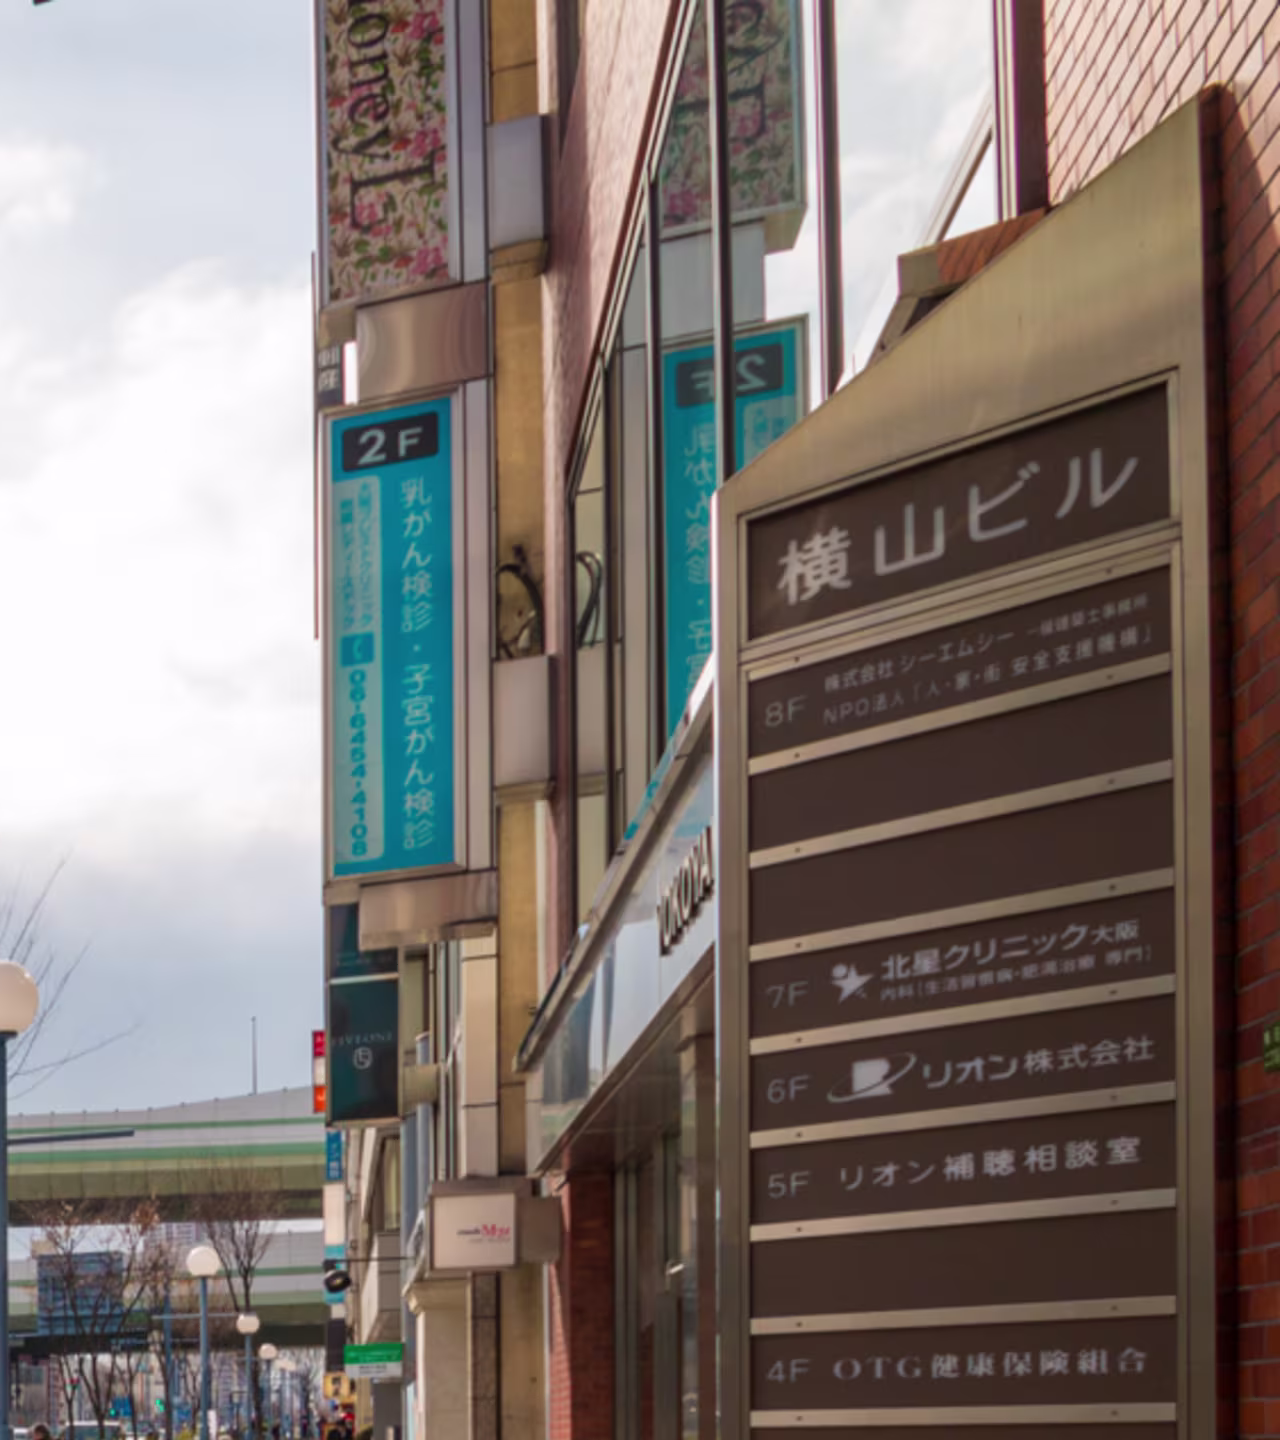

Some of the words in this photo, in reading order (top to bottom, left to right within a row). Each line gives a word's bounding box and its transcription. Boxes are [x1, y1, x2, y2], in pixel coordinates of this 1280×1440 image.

[332, 0, 435, 232] oneyL
[357, 425, 424, 466] 2F
[776, 447, 1140, 606] 横山ビル
[400, 476, 435, 850] 乳がん検診・子宮がん検診
[764, 693, 807, 728] 8F
[765, 979, 810, 1010] 7F
[880, 918, 1141, 982] 北星クリニック大阪
[765, 1074, 811, 1105] 6F
[920, 1034, 1156, 1090] リオン株式会社
[767, 1170, 811, 1200] 5F
[839, 1135, 1142, 1192] リオン補聴相談室
[766, 1357, 811, 1385] 4F
